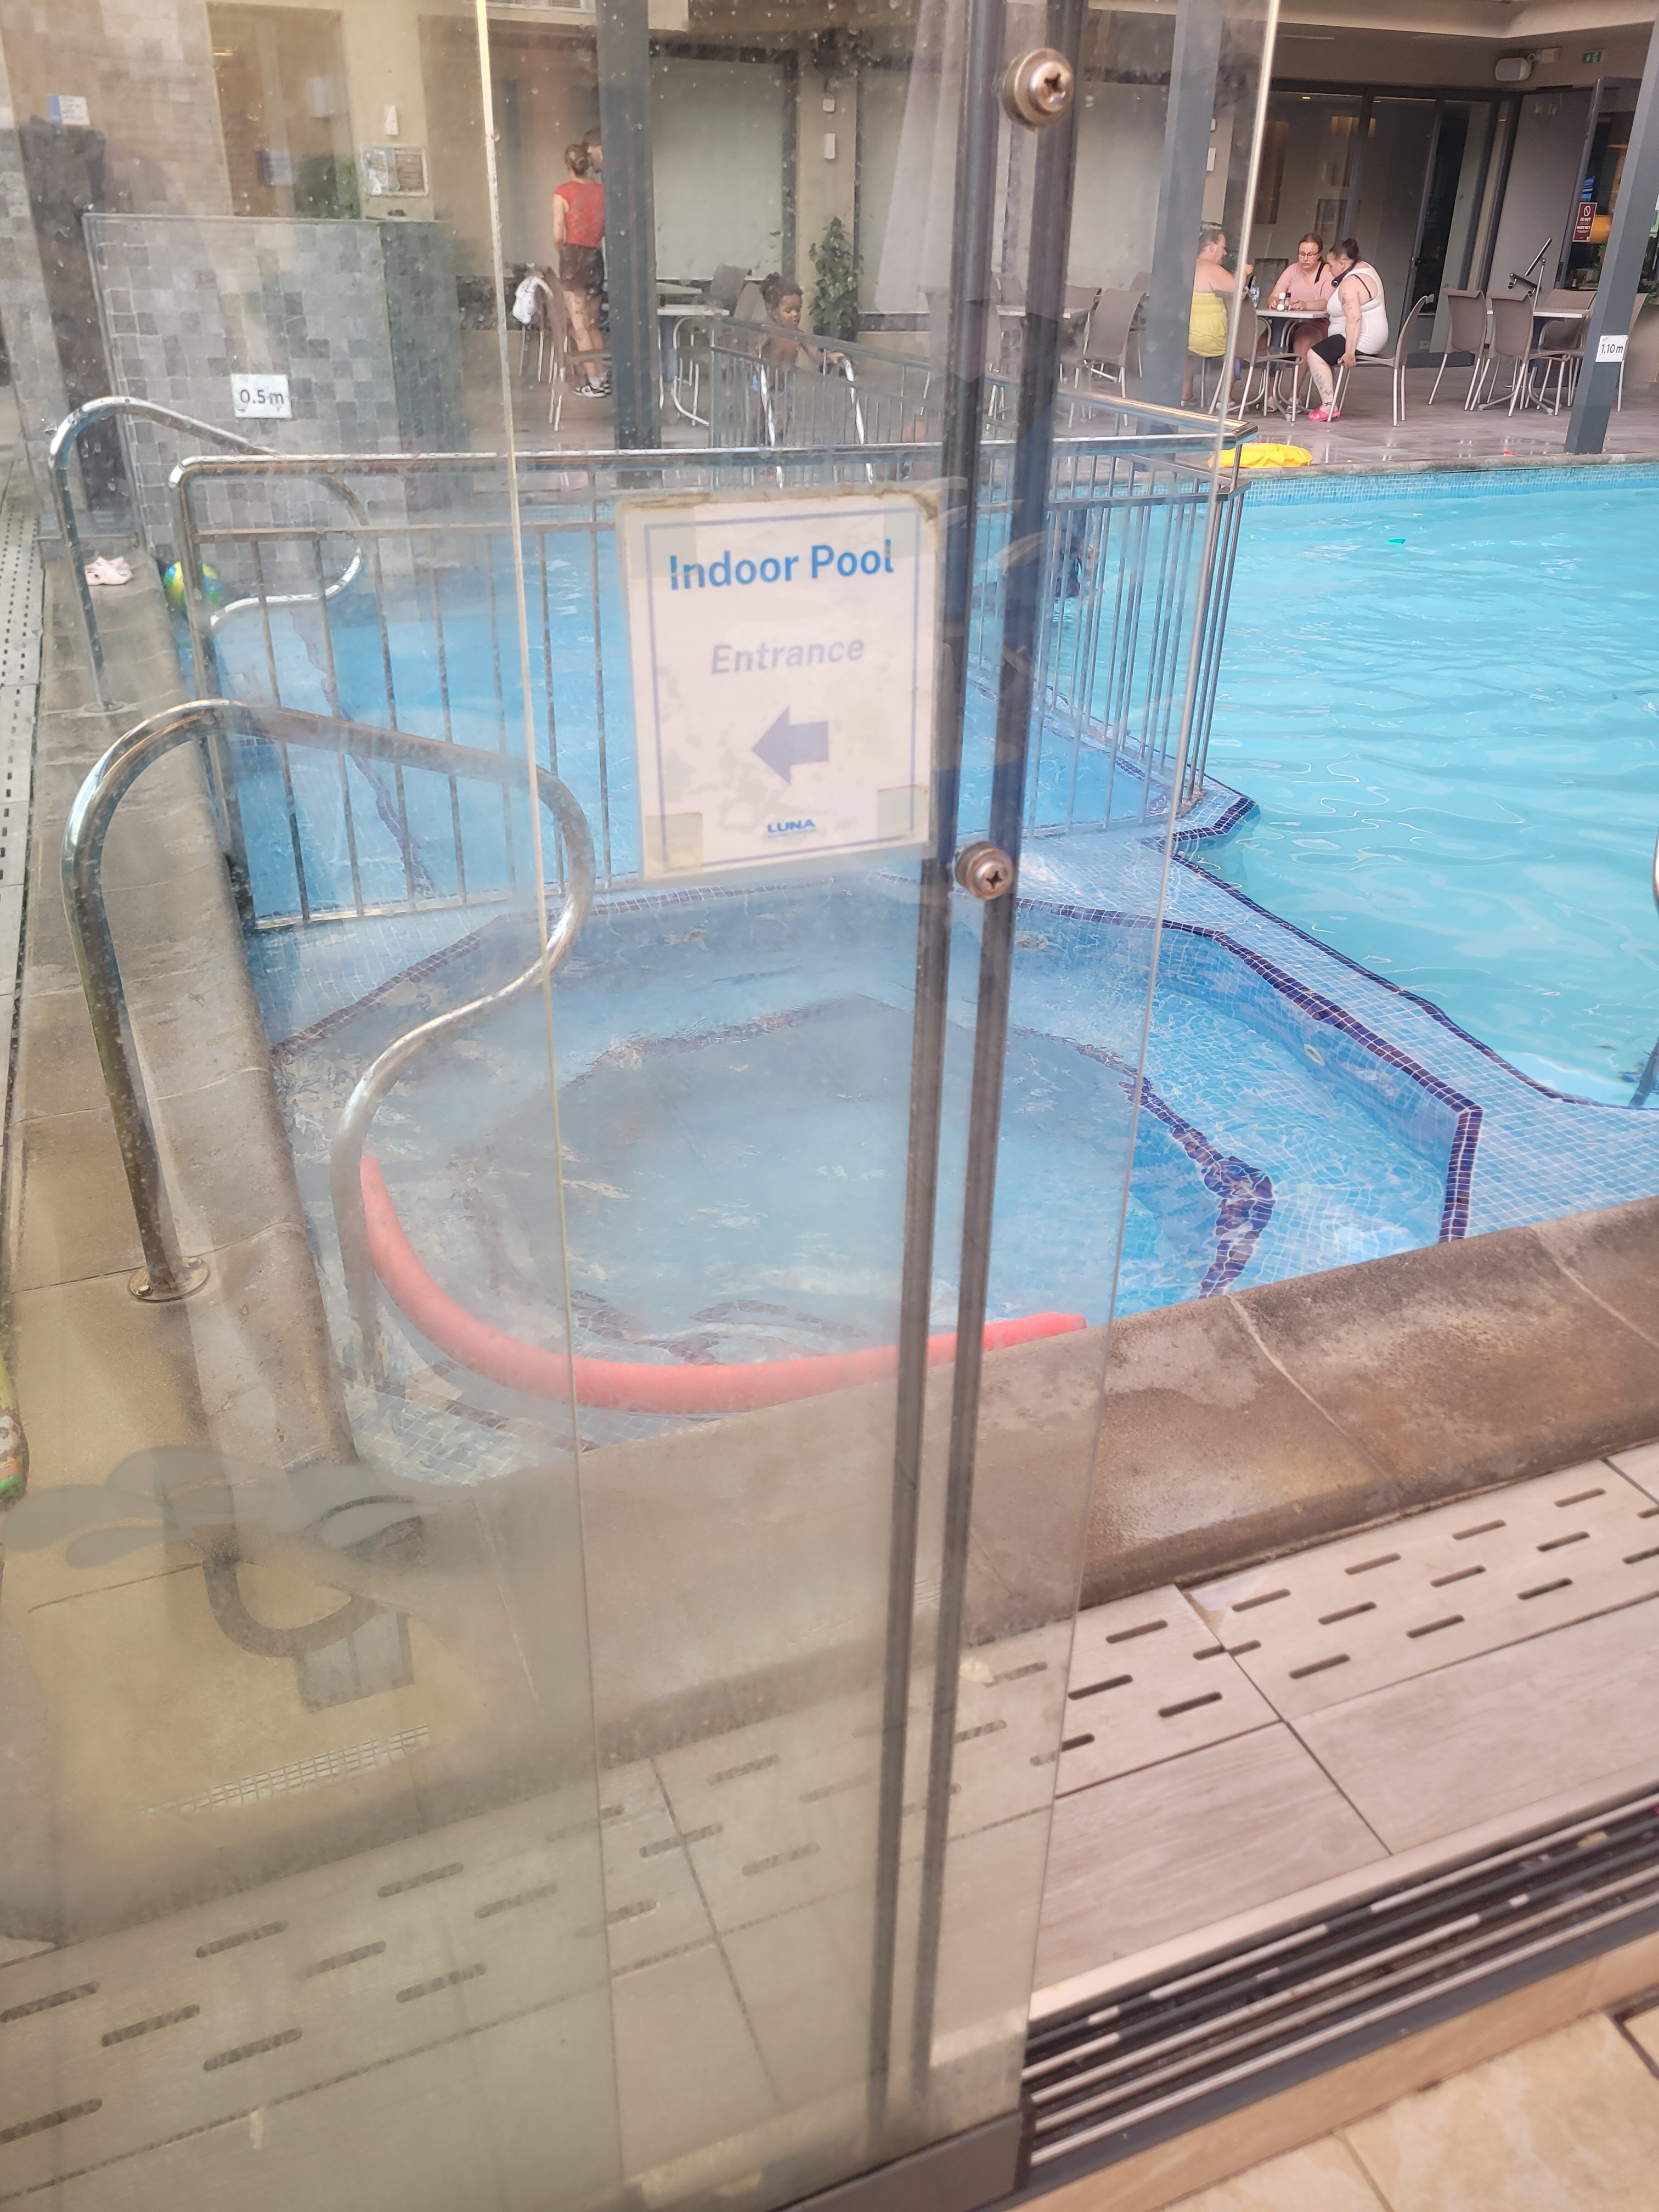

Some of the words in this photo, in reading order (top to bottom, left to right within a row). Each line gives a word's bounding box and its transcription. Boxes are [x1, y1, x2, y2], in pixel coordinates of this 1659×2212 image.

[240, 390, 284, 405] 0.5m
[670, 550, 799, 590] Indoor
[811, 539, 894, 579] Pool
[711, 639, 865, 674] Entrance
[768, 819, 816, 833] LUNA
